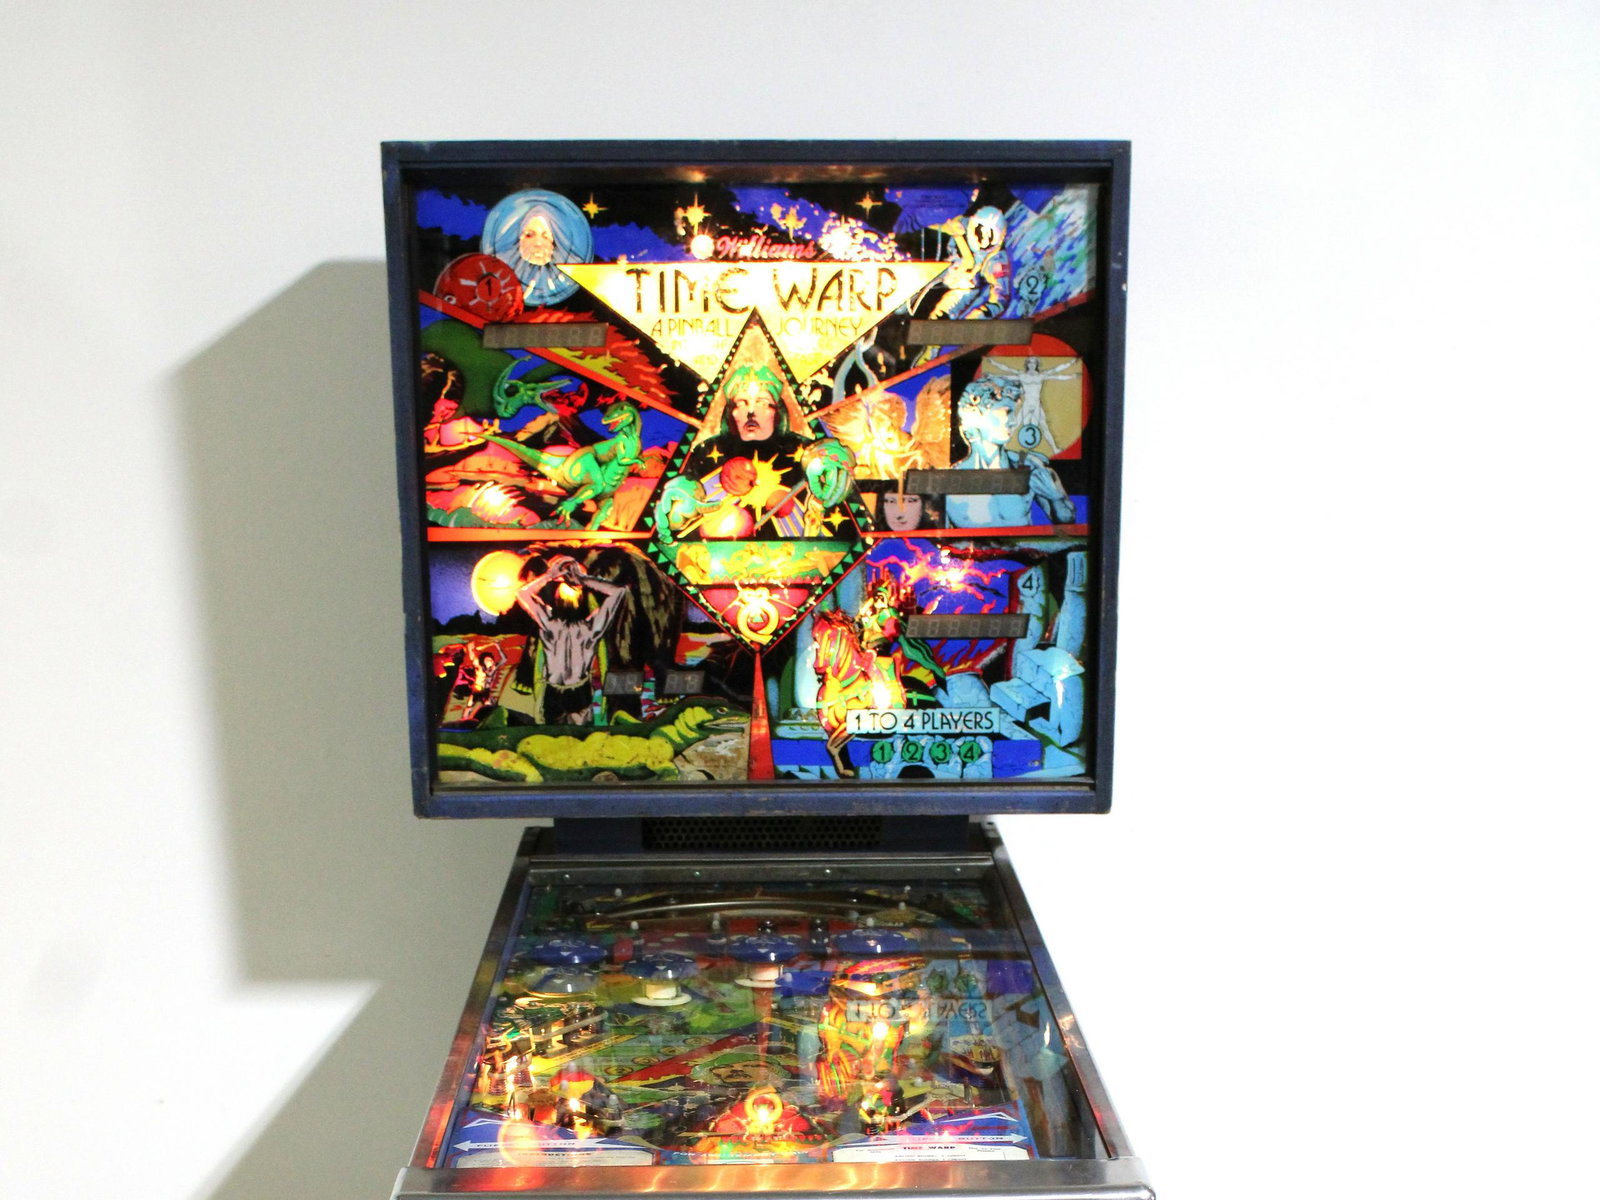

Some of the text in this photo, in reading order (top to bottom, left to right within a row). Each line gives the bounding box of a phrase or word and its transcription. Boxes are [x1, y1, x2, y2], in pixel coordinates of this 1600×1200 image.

[715, 235, 817, 259] Williams
[485, 277, 493, 297] 1
[625, 267, 898, 313] TIME WARP
[1025, 275, 1039, 295] 2
[650, 318, 663, 337] A
[1024, 426, 1037, 447] 3
[1022, 573, 1034, 591] 4
[855, 711, 995, 731] 1 TO 4 PLAYERS
[879, 743, 975, 761] 1 2 3 4
